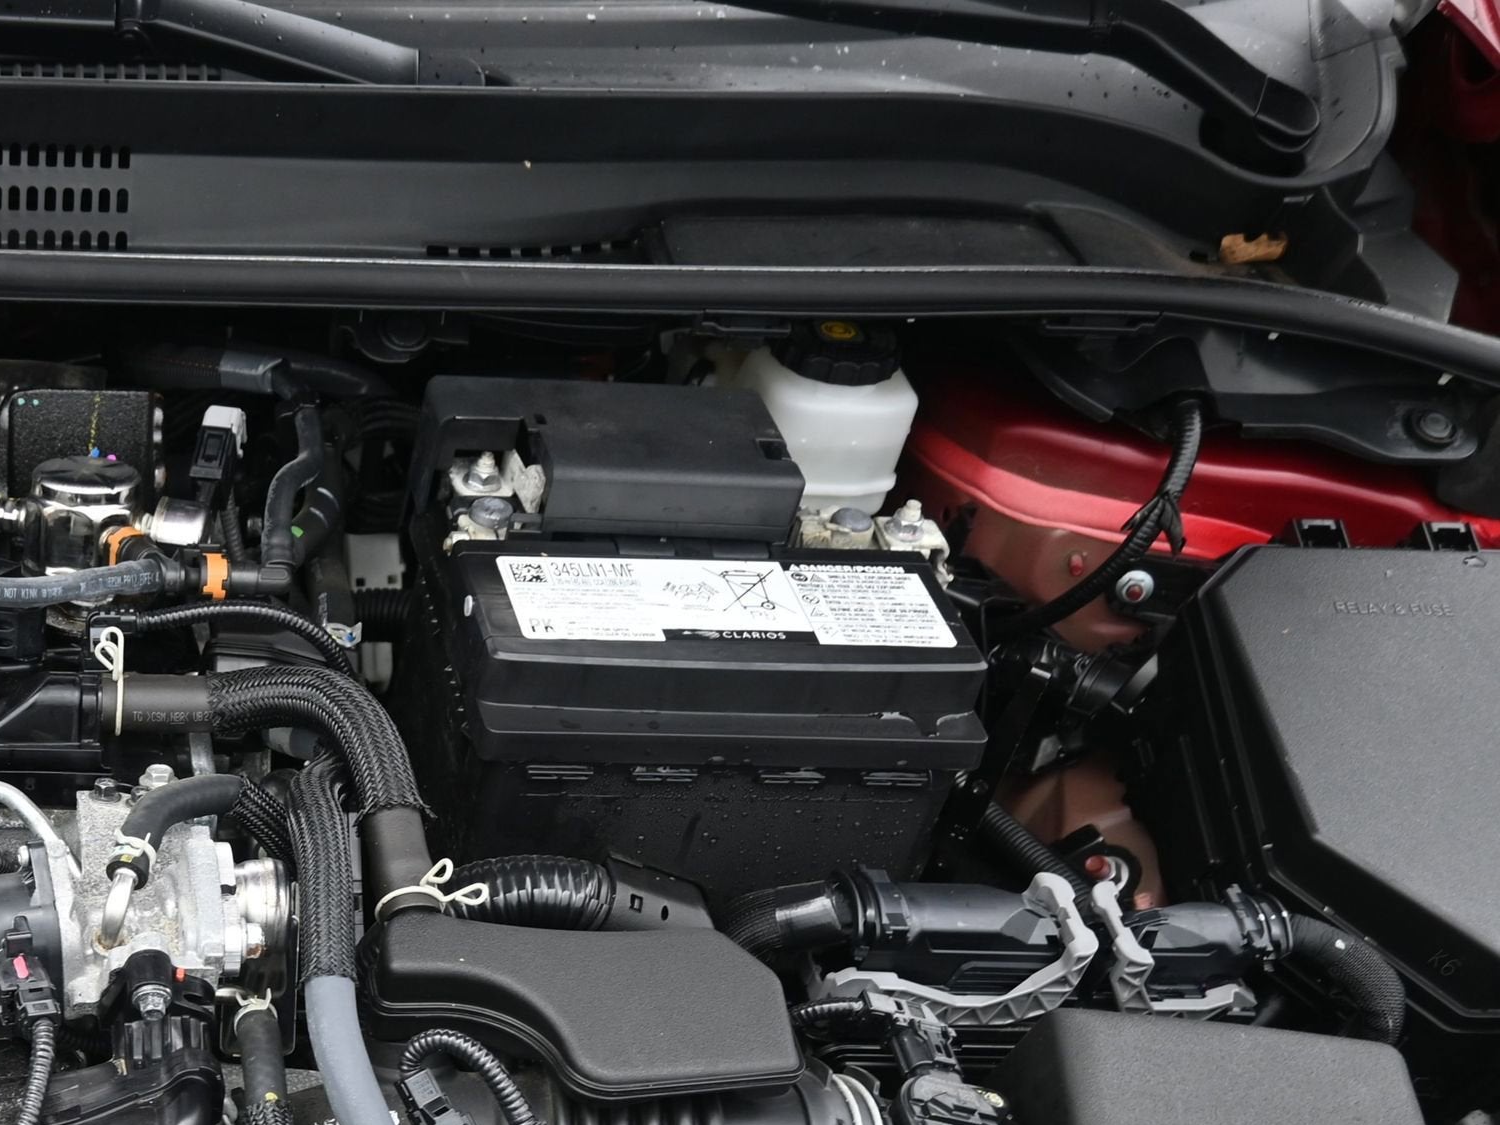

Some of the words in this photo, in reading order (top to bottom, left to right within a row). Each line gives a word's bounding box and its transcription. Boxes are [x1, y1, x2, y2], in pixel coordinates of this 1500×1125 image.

[550, 562, 635, 578] 345LN1-MF
[799, 564, 905, 574] DANGER/POISON
[3, 587, 18, 599] NOT
[20, 588, 38, 599] KINK
[1333, 600, 1388, 615] RELAY
[1393, 602, 1406, 616] &
[1409, 602, 1455, 617] FUSE
[722, 630, 787, 640] CLARIOS
